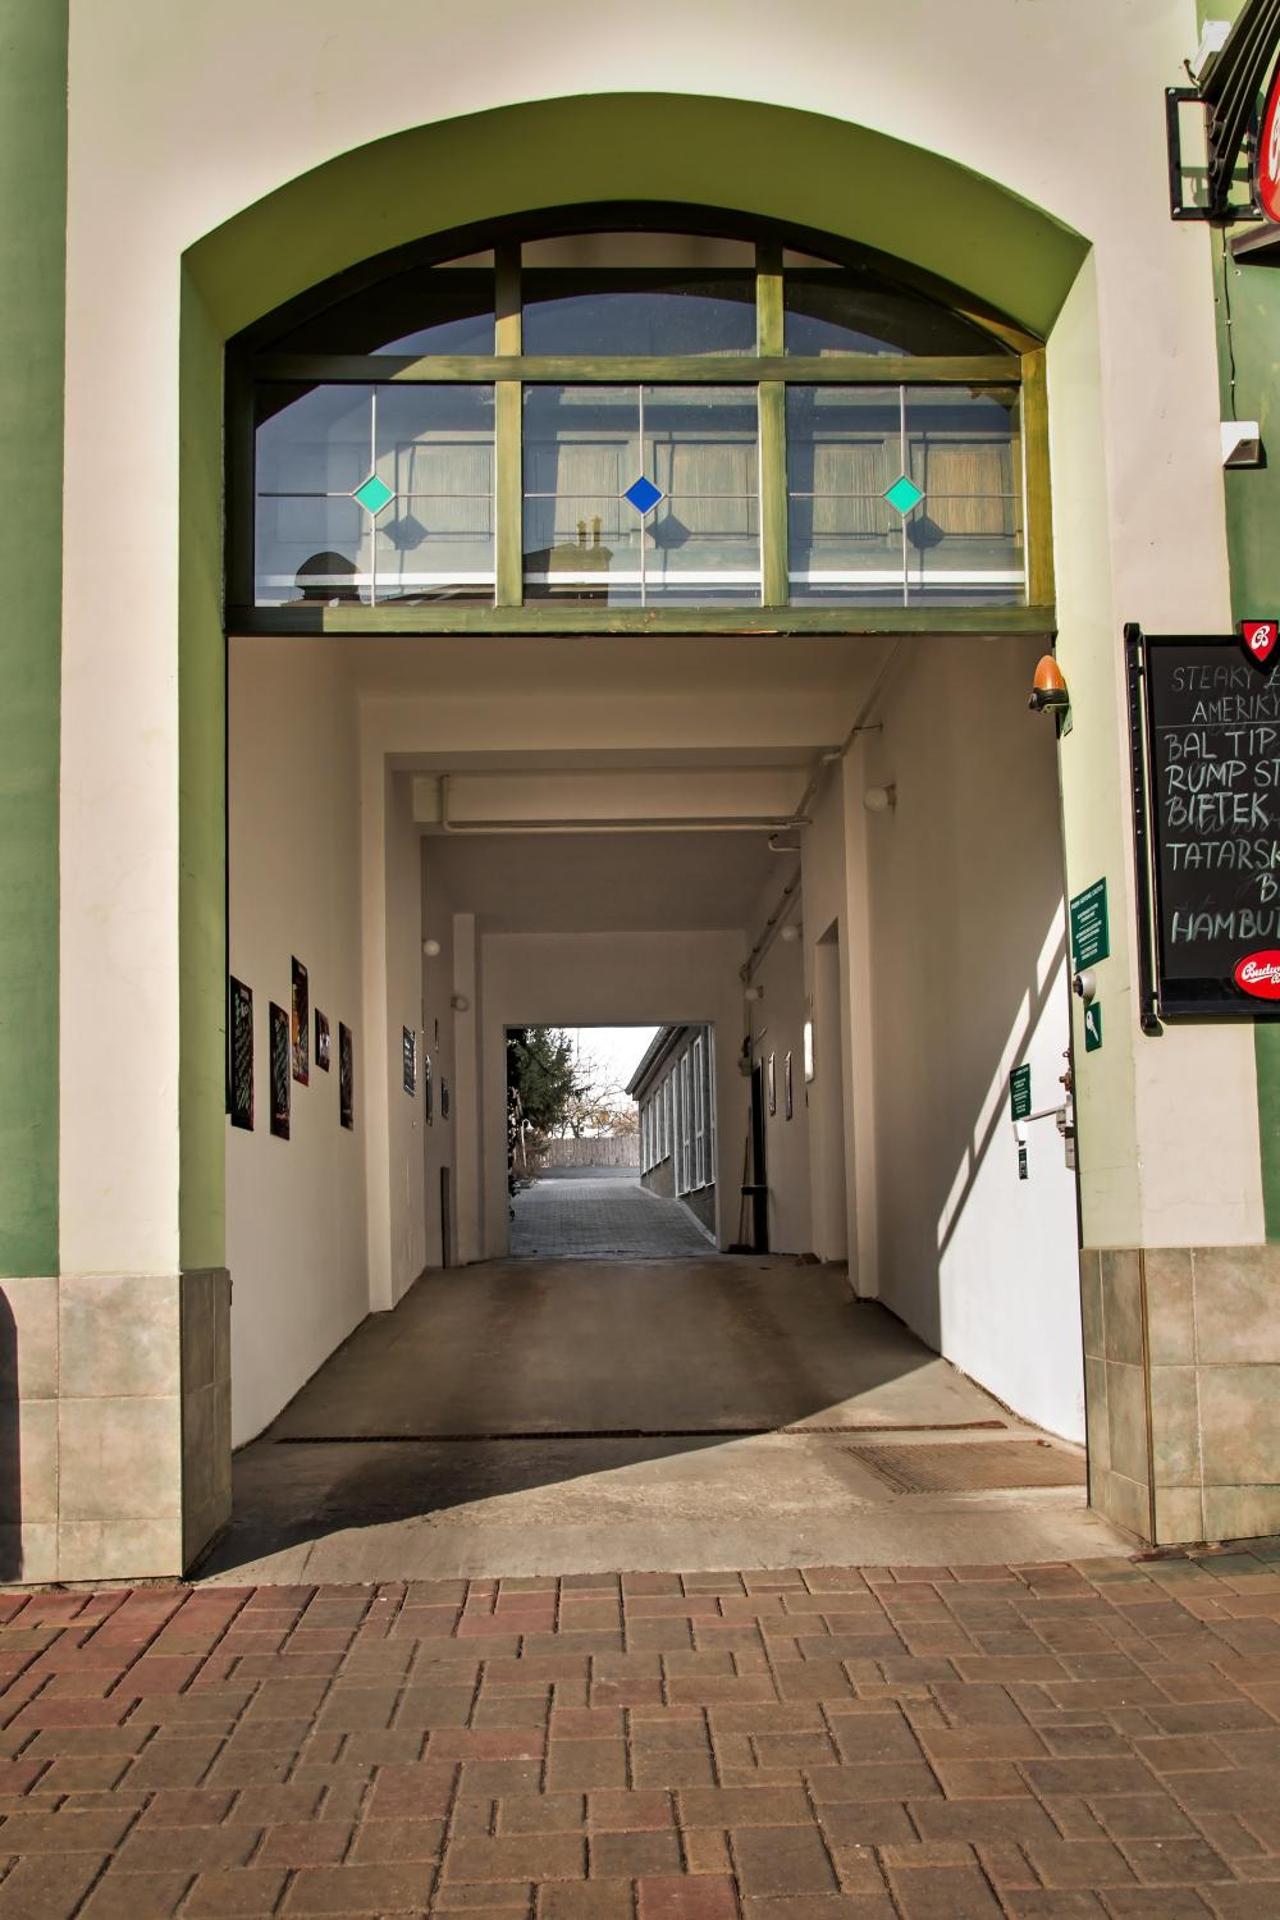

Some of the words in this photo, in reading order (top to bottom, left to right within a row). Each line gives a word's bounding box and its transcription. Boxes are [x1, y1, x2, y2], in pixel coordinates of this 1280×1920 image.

[1171, 665, 1252, 692] STEAKY
[1191, 694, 1280, 723] AMERIKY
[1164, 730, 1217, 761] BAL
[1224, 727, 1278, 757] TIP
[1164, 759, 1248, 795] RUMP
[1165, 791, 1270, 829] BIFTEK
